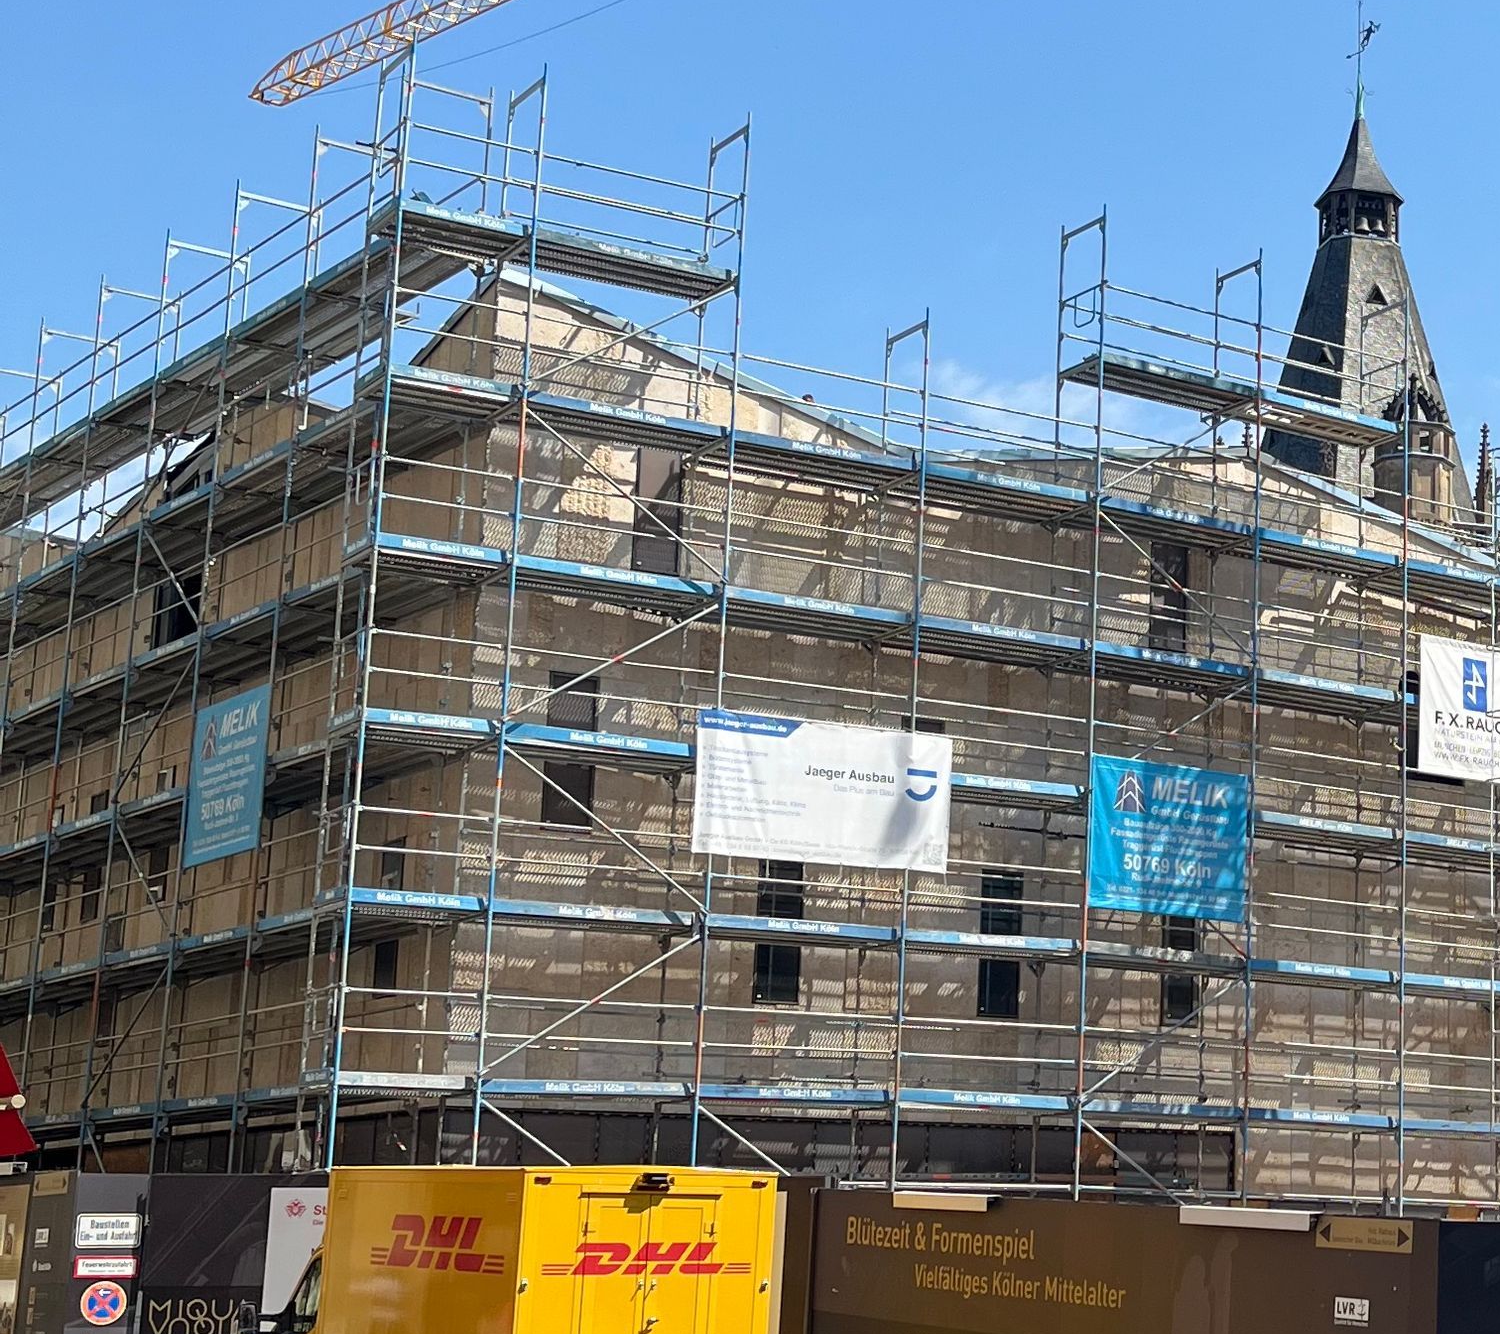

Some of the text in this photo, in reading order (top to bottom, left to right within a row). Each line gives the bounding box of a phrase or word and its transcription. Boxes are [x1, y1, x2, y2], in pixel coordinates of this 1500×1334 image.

[426, 206, 505, 229] Melik GmbH Köln
[441, 373, 470, 385] GmbH
[472, 377, 495, 389] Köln
[590, 403, 667, 425] Melik GmbH Köln
[792, 441, 862, 460] Melik GmbH Köln
[999, 477, 1021, 487] GmbH
[1023, 480, 1041, 491] Köln
[403, 538, 485, 558] Melik GmbH Köln
[581, 566, 657, 585] Melik GmbH Köln
[784, 596, 855, 615] Melik GmbH Köln
[972, 623, 1037, 641] Melik GmbH Köln
[219, 700, 263, 739] MELIK
[390, 712, 473, 729] Melik GmbH Köln
[704, 715, 787, 734] www.jaeger-ausbau.de
[1435, 710, 1445, 726] F.
[1449, 712, 1463, 728] X.
[570, 732, 648, 749] Melik GmbH Köln
[804, 765, 895, 784] Jaeger Ausbau
[965, 776, 1031, 790] Melik GmbH Köln
[1151, 776, 1230, 809] MELIK
[225, 794, 245, 813] Köln
[1150, 805, 1181, 818] GmbH
[1123, 853, 1211, 879] 50769 Köln
[377, 891, 461, 908] Melik GmbH Köln
[560, 906, 637, 920] Melik GmbH Köln
[768, 919, 840, 934] Melik GmbH Köln
[546, 1081, 625, 1093] Melik GmbH Köln
[953, 1092, 1021, 1105] Melik GmbH Köln
[1292, 1112, 1350, 1123] Melik GmbH Köln
[90, 1218, 130, 1230] Baustellen
[79, 1230, 138, 1242] Ein- und Ausfahrt
[387, 1214, 486, 1273] DHL
[846, 1216, 1036, 1266] Blütezeit & Formenspiel
[570, 1242, 725, 1276] DHL
[914, 1263, 1127, 1309] Vielfältiges Kölner Mittelalter
[1336, 1301, 1355, 1316] LVR
